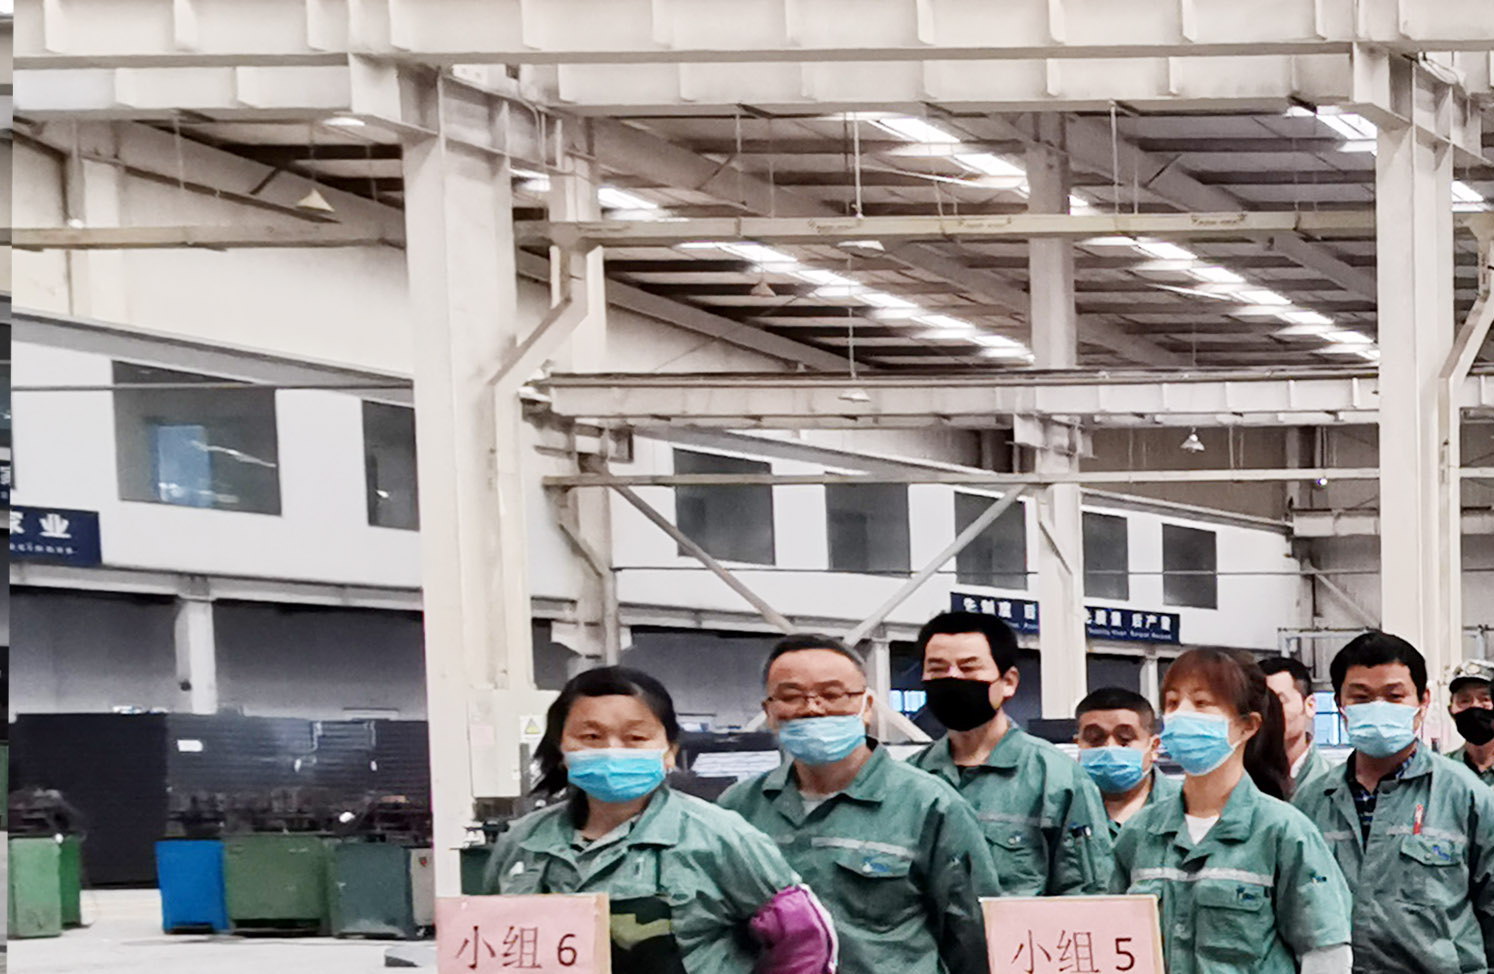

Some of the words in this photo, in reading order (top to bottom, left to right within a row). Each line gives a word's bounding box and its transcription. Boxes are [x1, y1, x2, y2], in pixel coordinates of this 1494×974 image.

[456, 925, 543, 971] 小组
[556, 933, 578, 968] 6
[1114, 936, 1136, 973] 5
